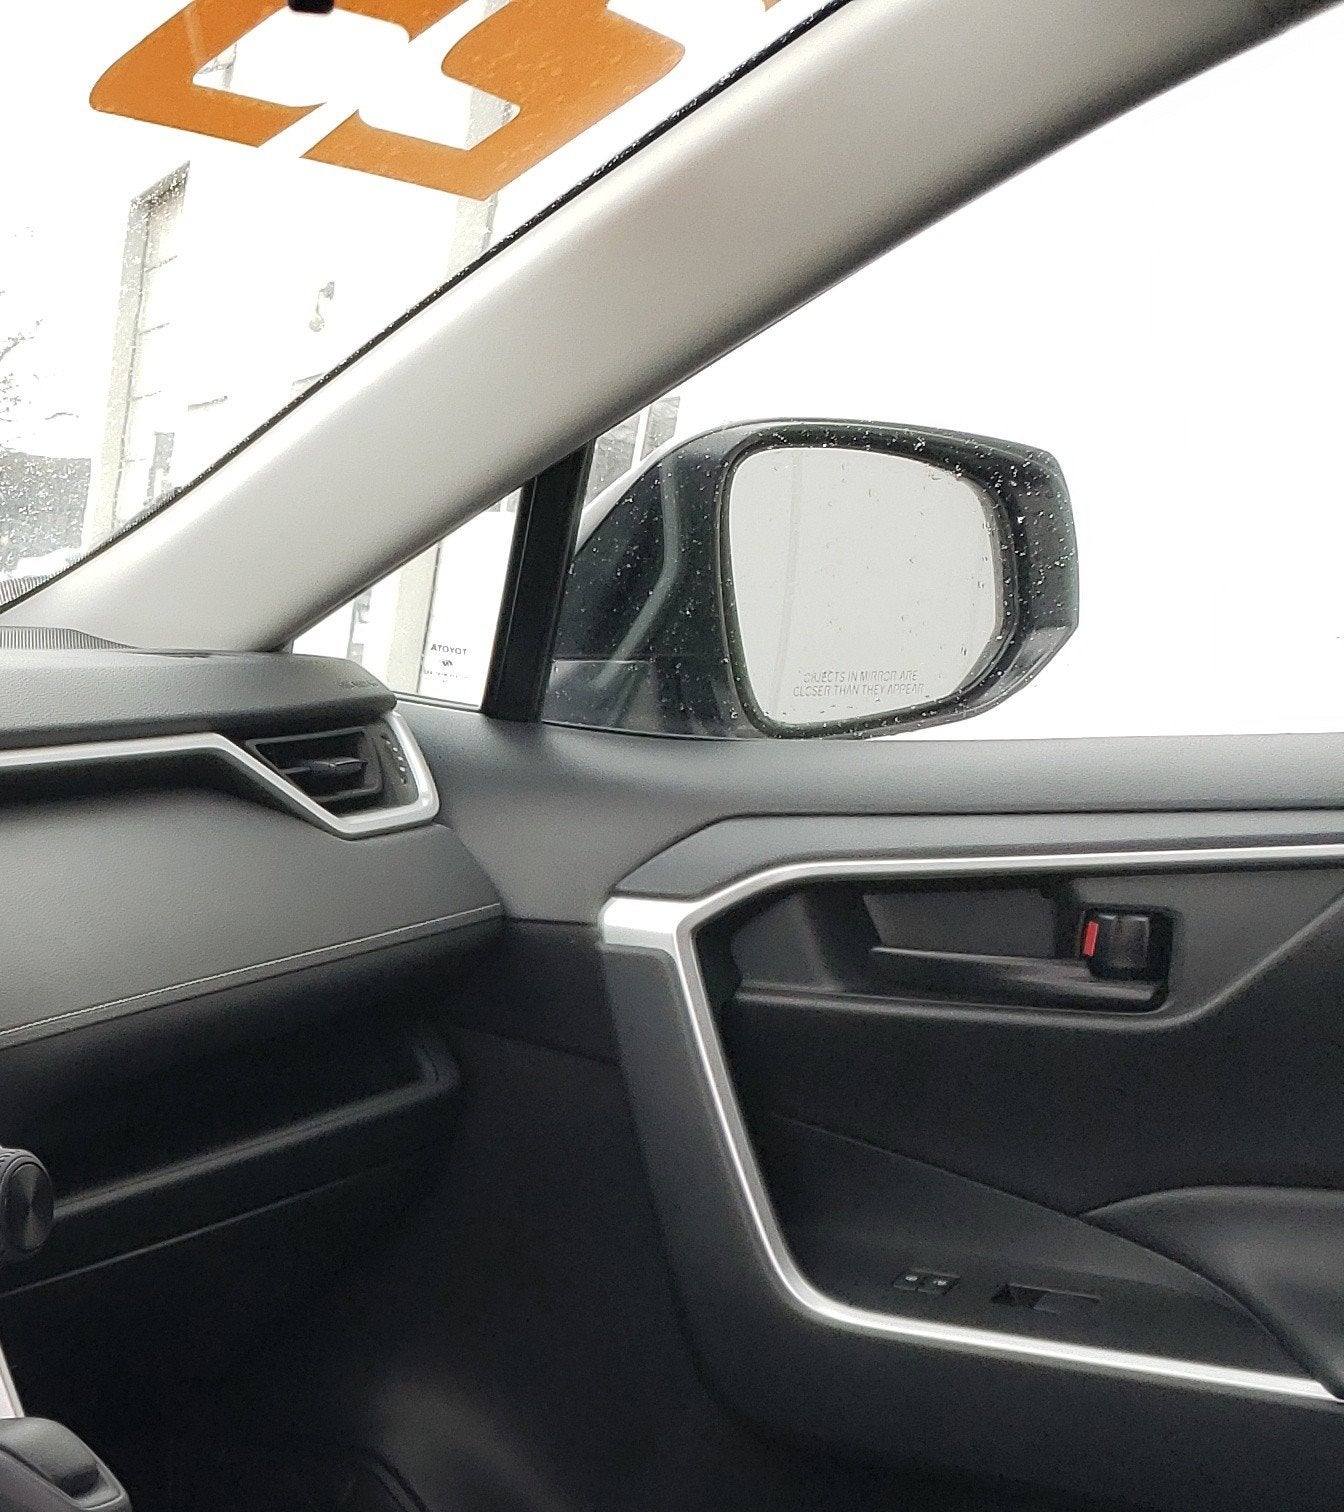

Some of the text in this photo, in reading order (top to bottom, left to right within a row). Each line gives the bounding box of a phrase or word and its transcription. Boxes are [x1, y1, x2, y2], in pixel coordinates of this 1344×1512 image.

[803, 668, 919, 683] OBJECTS IN MIRROR ARE
[793, 682, 925, 697] CLOSER THAN THEY APPEAR
